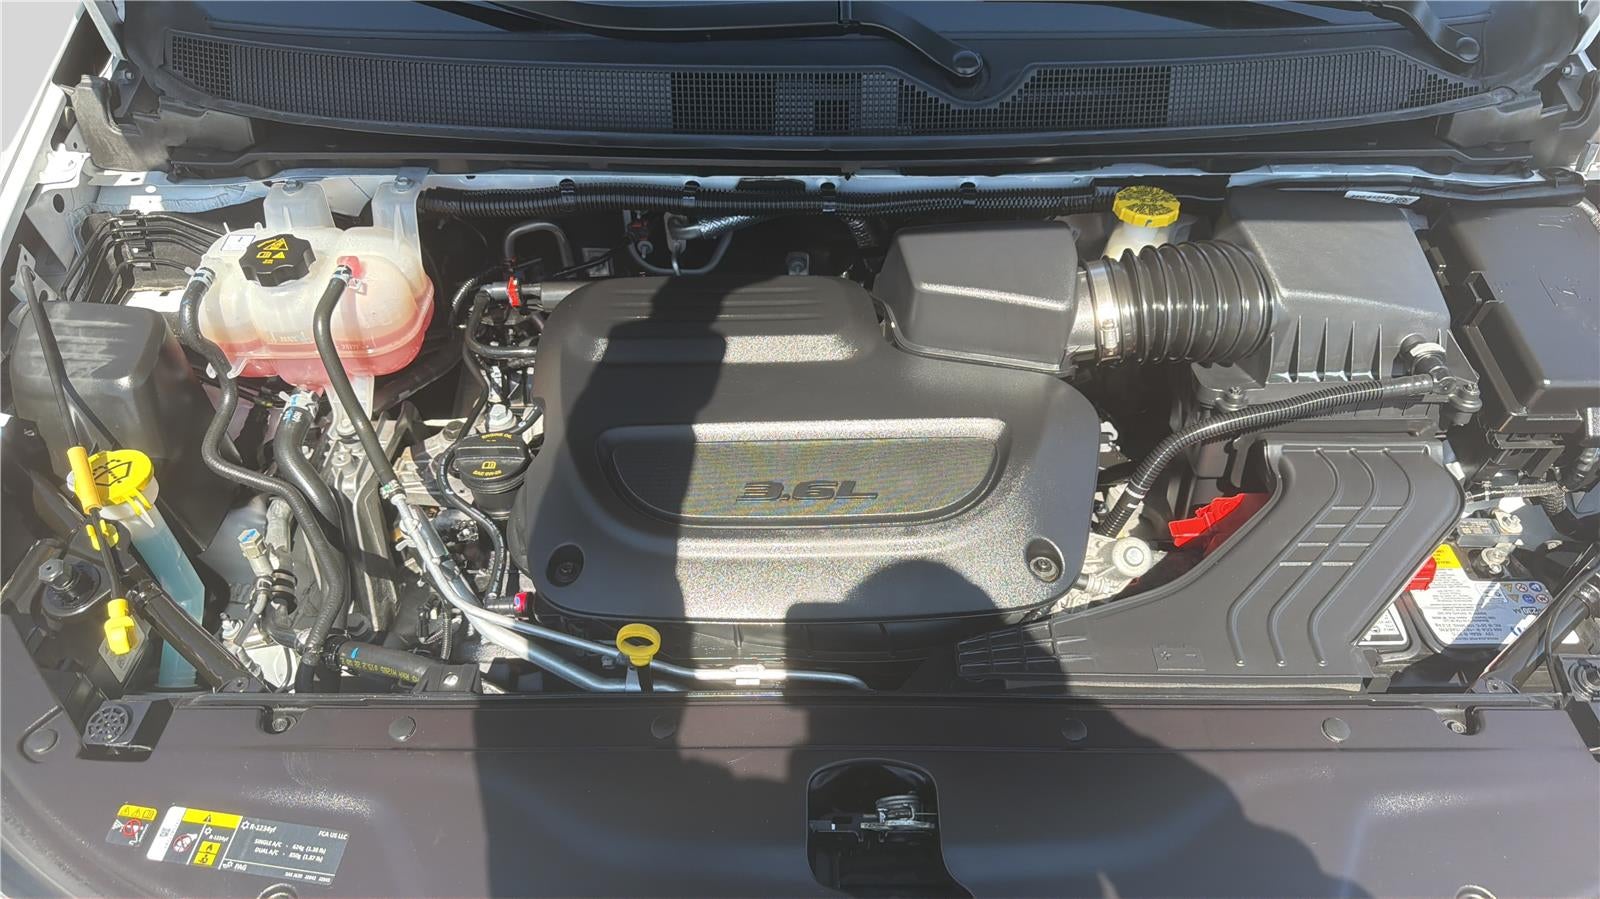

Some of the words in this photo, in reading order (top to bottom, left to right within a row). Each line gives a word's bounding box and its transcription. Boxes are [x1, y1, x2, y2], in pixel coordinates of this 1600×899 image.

[736, 480, 878, 501] 3.6L
[249, 824, 277, 834] R-1234yf
[318, 830, 330, 838] FCA
[329, 831, 339, 839] US
[338, 832, 349, 840] LLC
[254, 838, 272, 846] SINGLE
[271, 840, 283, 848] A/C
[254, 846, 269, 854] DUAL
[268, 848, 280, 856] A/C
[234, 862, 248, 871] PAG
